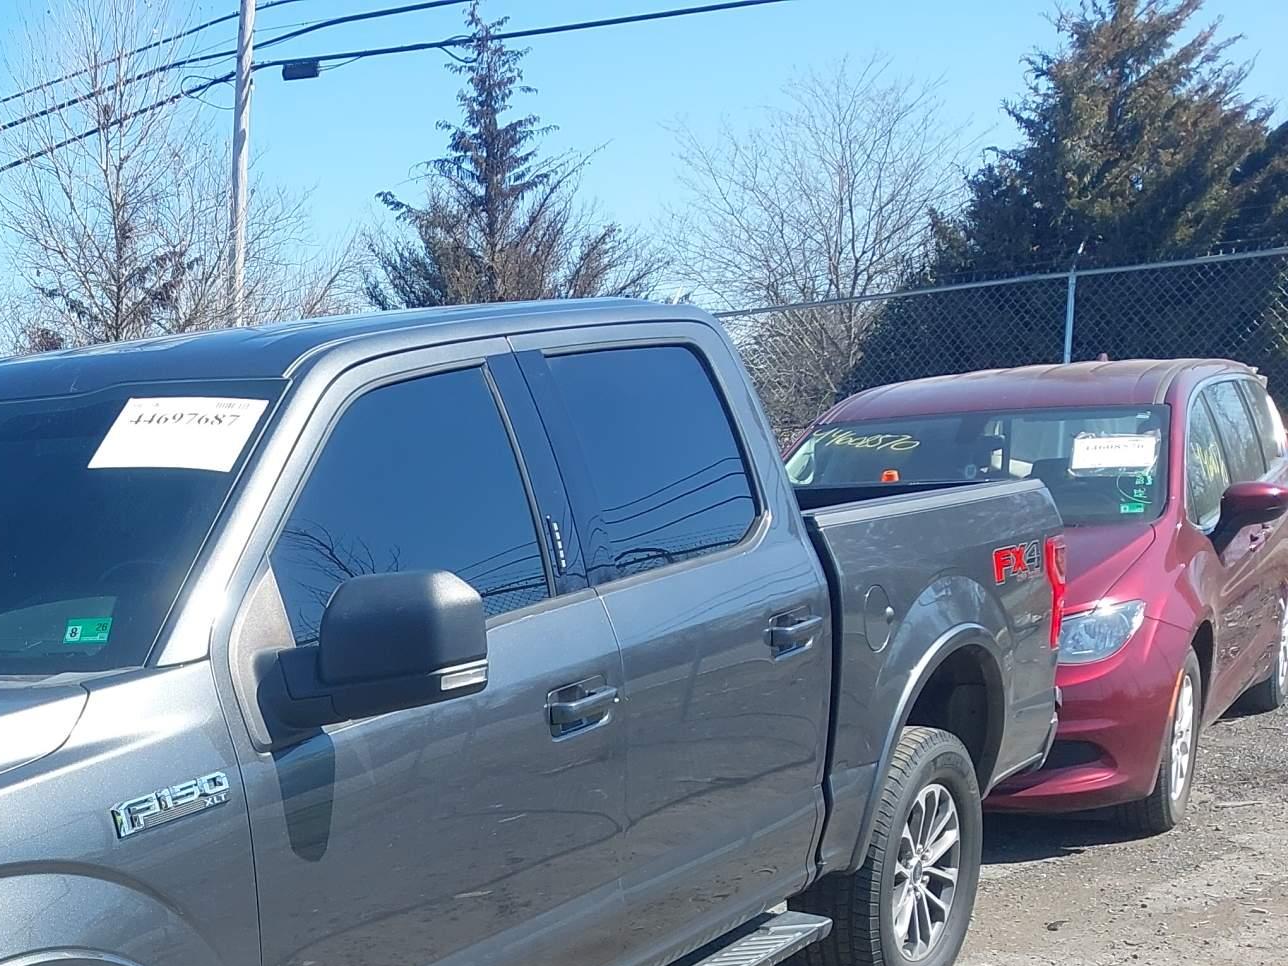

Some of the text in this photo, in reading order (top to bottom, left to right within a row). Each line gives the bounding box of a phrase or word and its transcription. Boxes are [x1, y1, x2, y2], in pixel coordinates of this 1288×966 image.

[129, 412, 241, 426] 44697687
[993, 540, 1040, 586] FX4
[69, 627, 78, 638] 8
[205, 792, 227, 807] XLT
